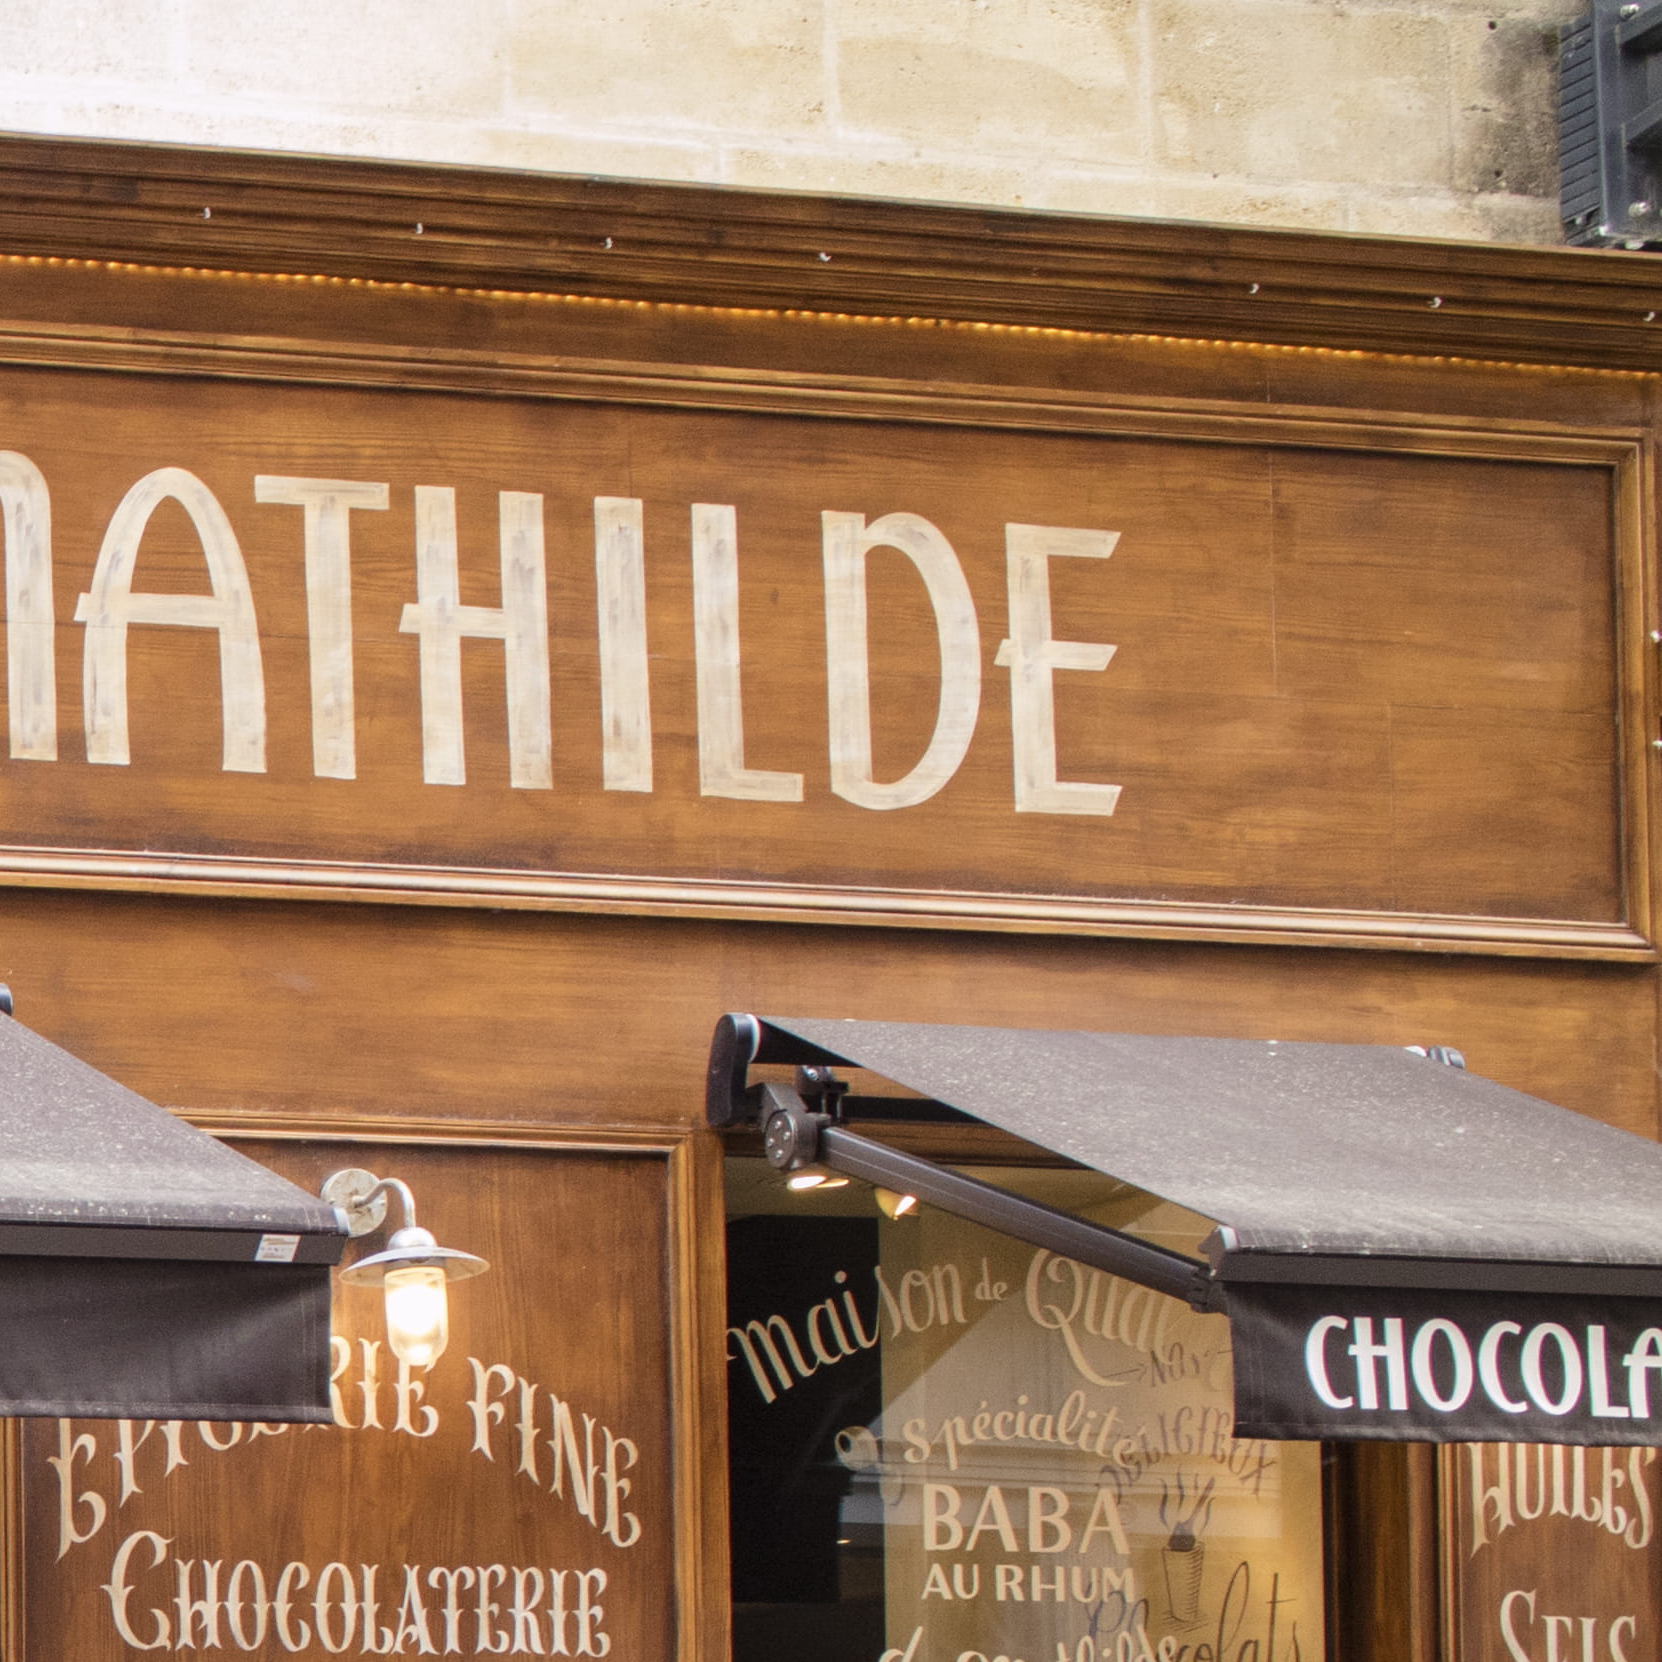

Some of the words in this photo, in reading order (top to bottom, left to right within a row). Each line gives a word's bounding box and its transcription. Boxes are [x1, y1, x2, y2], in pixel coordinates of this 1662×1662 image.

[975, 1257, 1008, 1301] de
[468, 1357, 641, 1548] FINE
[923, 1484, 1131, 1555] BABA
[1468, 1443, 1656, 1559] HUILES
[101, 1529, 612, 1659] CHOCOLATERIE
[922, 1564, 980, 1601] AU
[995, 1565, 1136, 1603] RHUM
